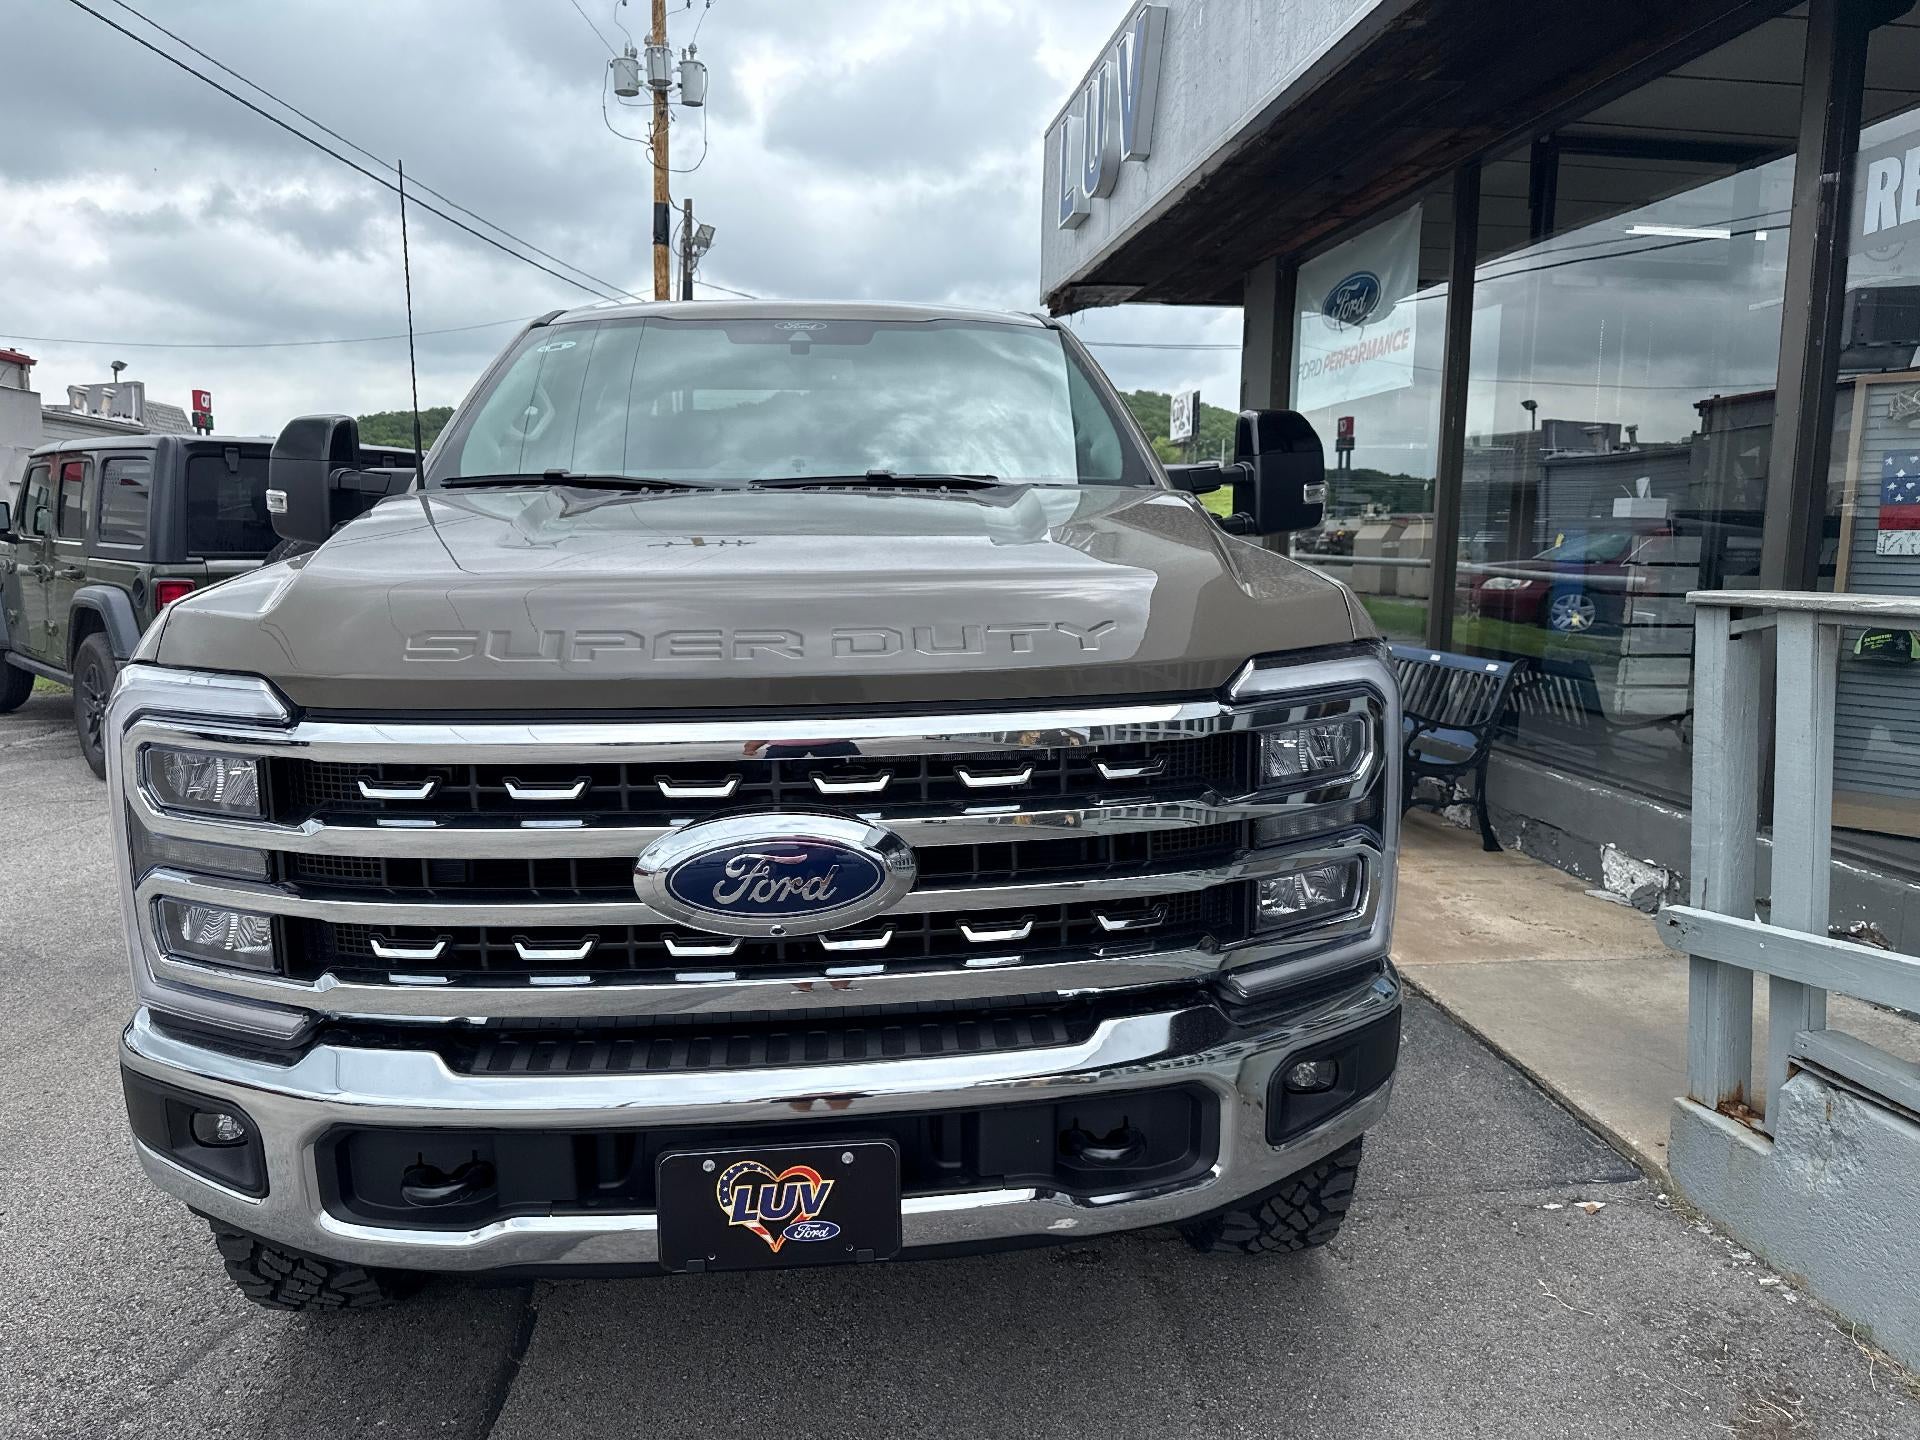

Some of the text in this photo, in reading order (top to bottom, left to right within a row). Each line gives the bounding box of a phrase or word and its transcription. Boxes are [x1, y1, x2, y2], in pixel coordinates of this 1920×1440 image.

[1059, 4, 1168, 229] LUV
[1332, 282, 1369, 321] Ford
[1323, 328, 1410, 373] PERFORMANCE
[403, 620, 1117, 662] SUPER DUTY
[712, 853, 840, 905] Ford
[729, 1180, 835, 1225] LUV
[794, 1224, 829, 1239] Ford
